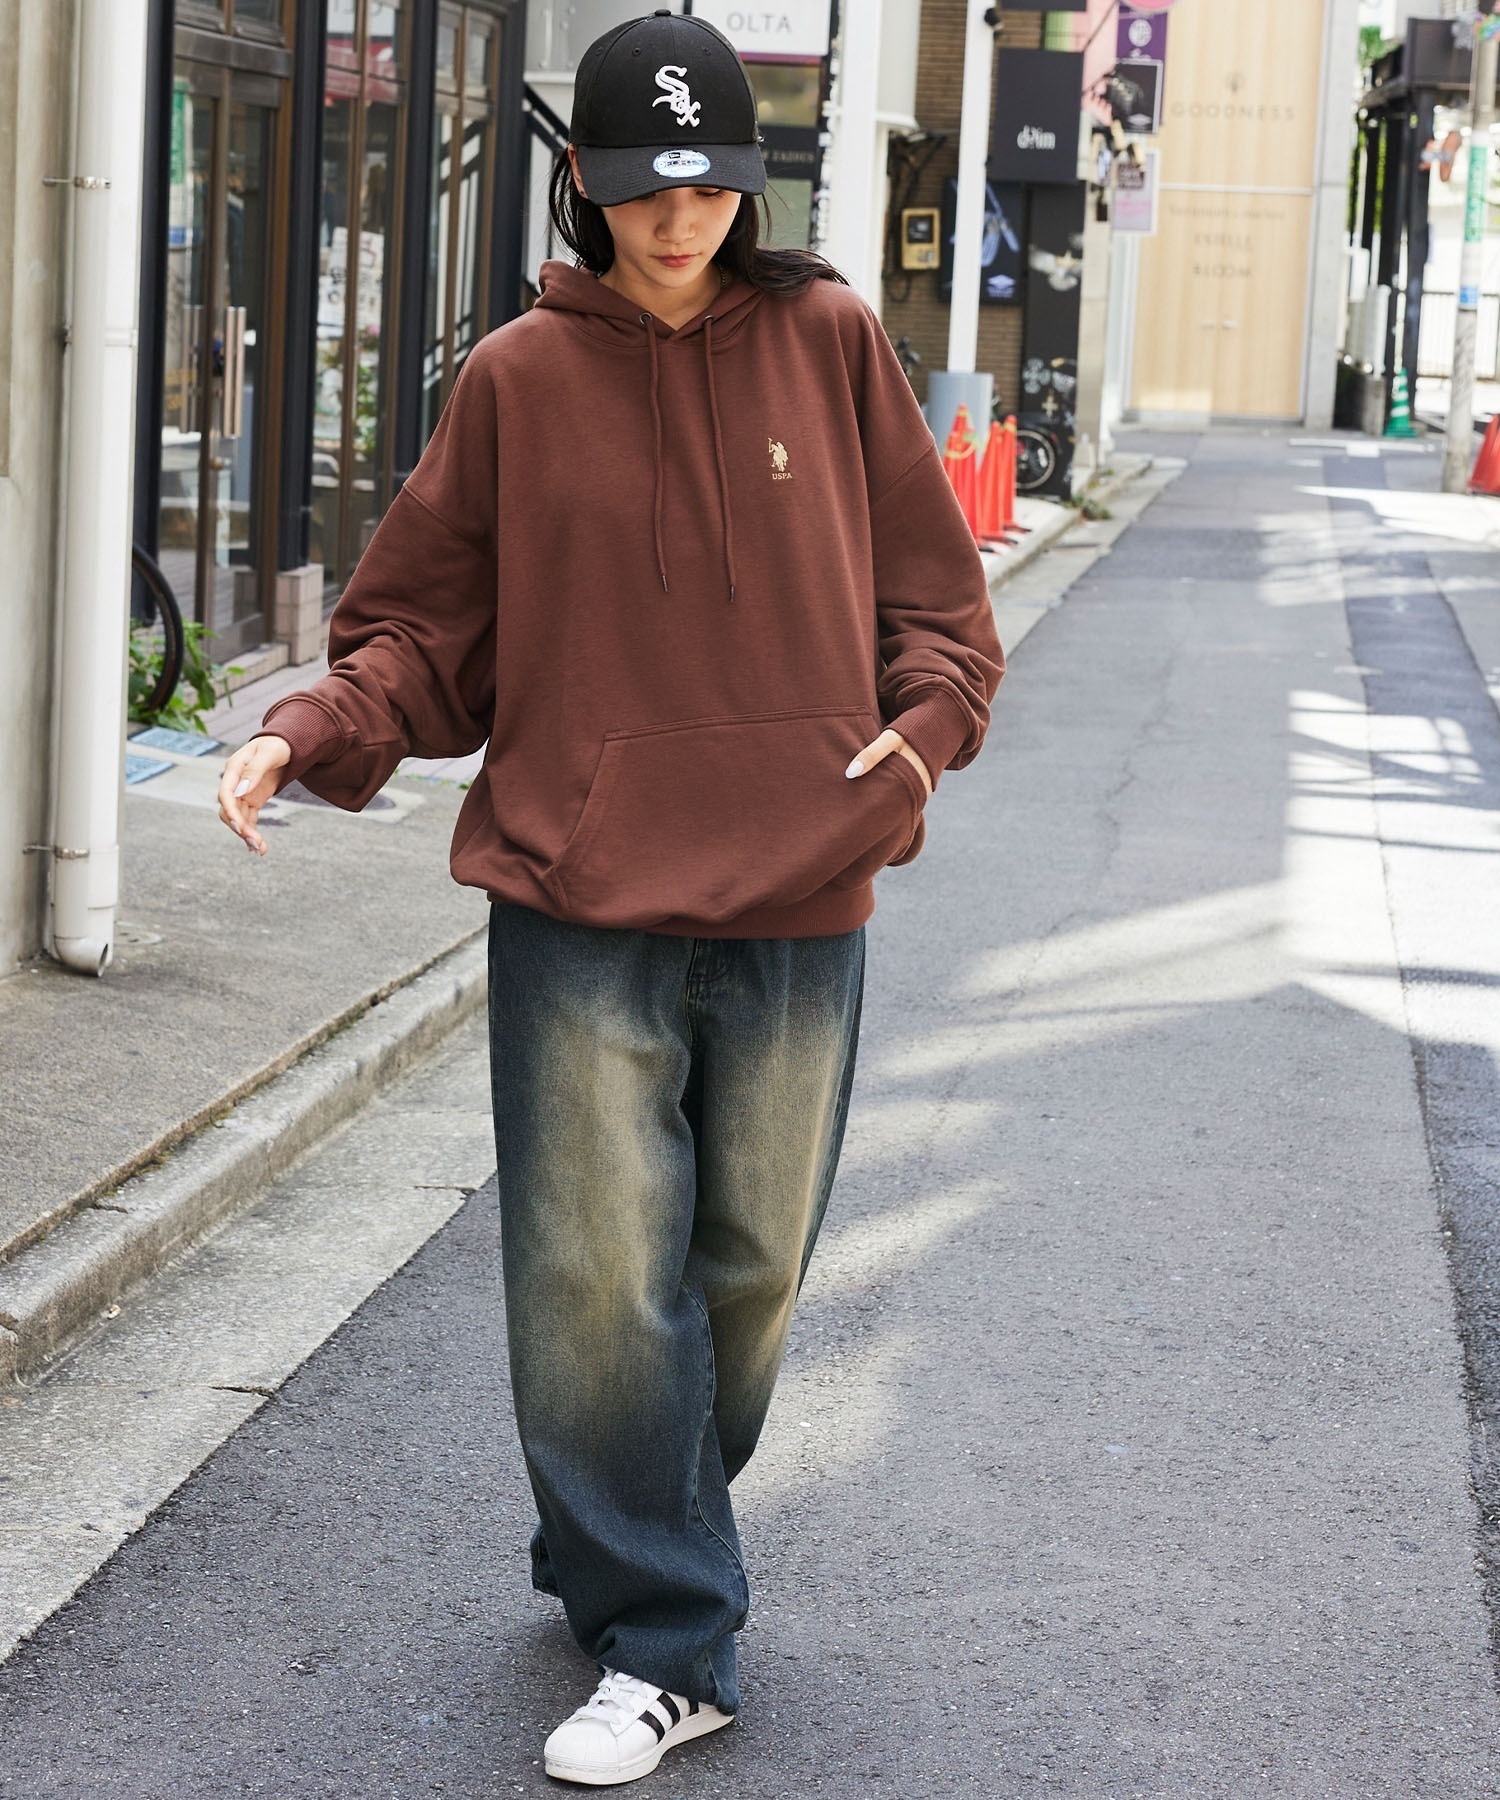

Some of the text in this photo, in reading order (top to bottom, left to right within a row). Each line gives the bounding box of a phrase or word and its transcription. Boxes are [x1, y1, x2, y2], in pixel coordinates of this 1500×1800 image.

[726, 11, 793, 33] OLTA
[651, 65, 702, 127] Sox
[1170, 101, 1296, 121] GOODNESS
[771, 472, 793, 480] USPA
